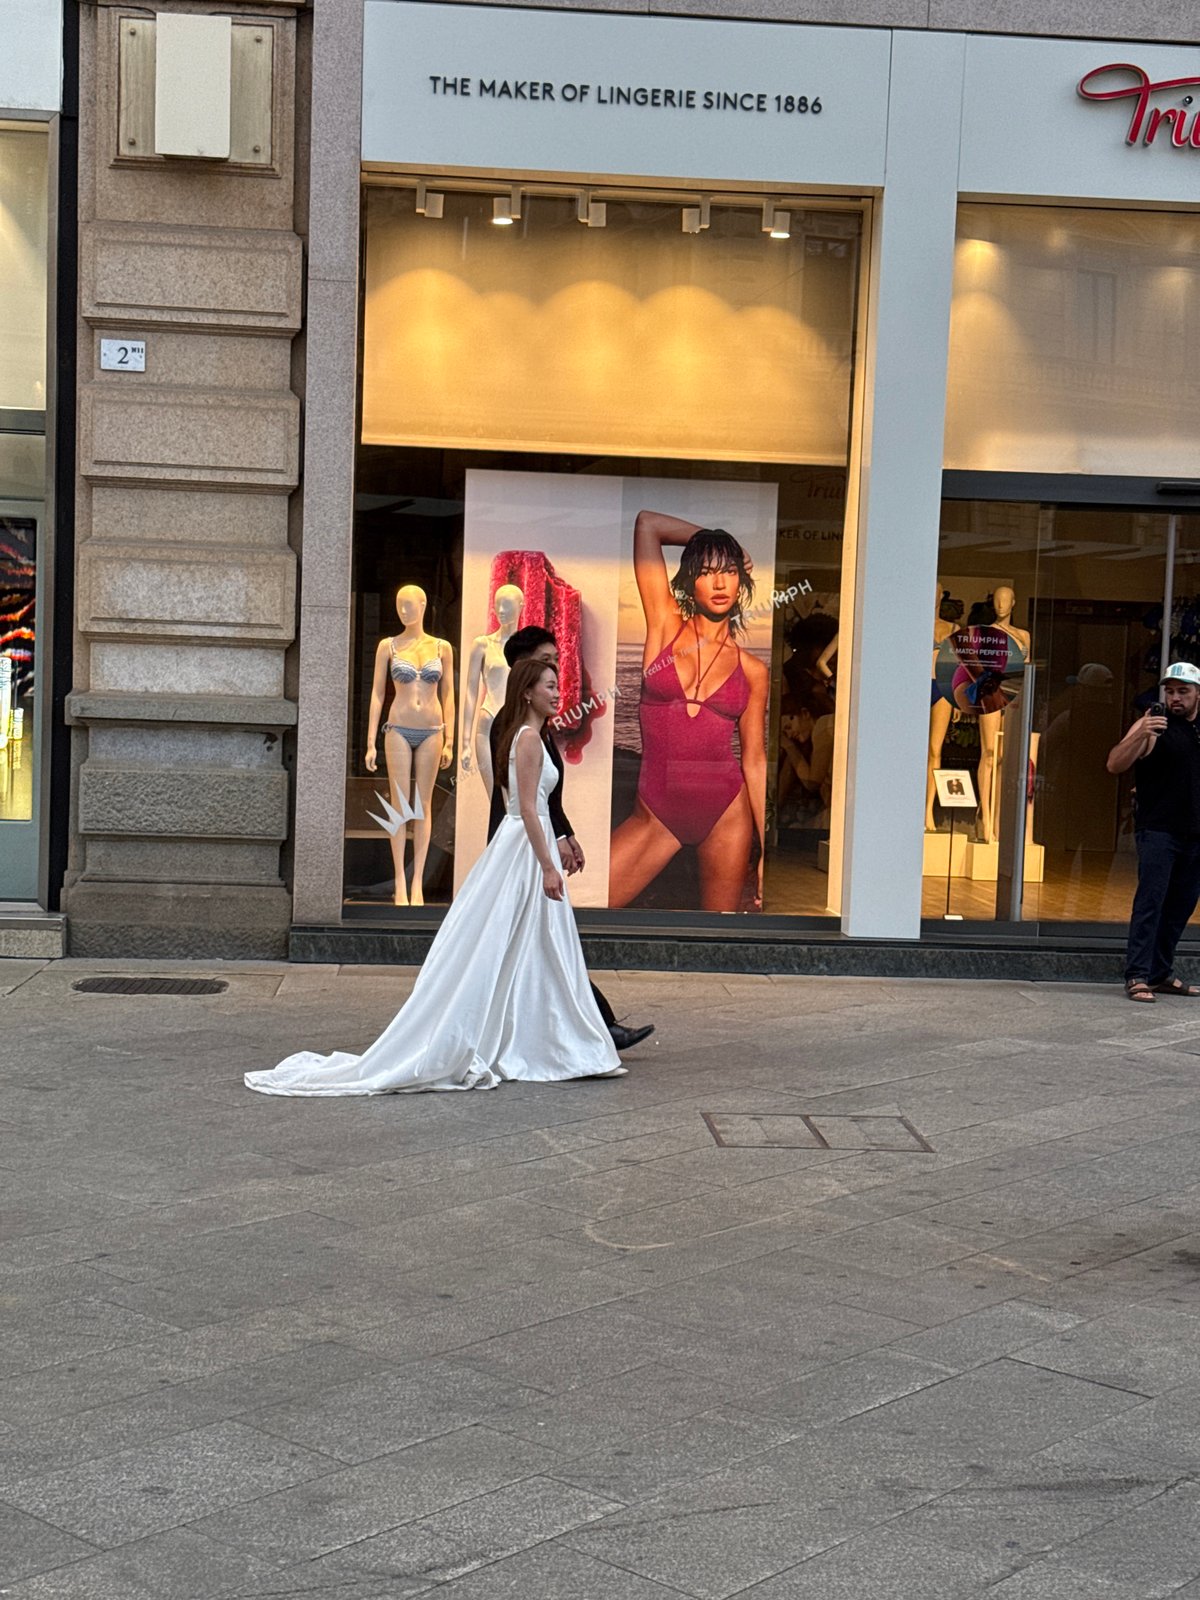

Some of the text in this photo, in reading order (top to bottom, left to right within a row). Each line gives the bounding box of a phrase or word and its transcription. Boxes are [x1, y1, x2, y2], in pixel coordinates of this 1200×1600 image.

[429, 75, 823, 115] THE MAKER OF LINGERIE SINCE 1886
[117, 346, 130, 364] 2
[778, 529, 800, 539] KER
[821, 530, 843, 541] LIN
[957, 635, 998, 644] TRIUMPH
[551, 684, 622, 731] RIUMPH
